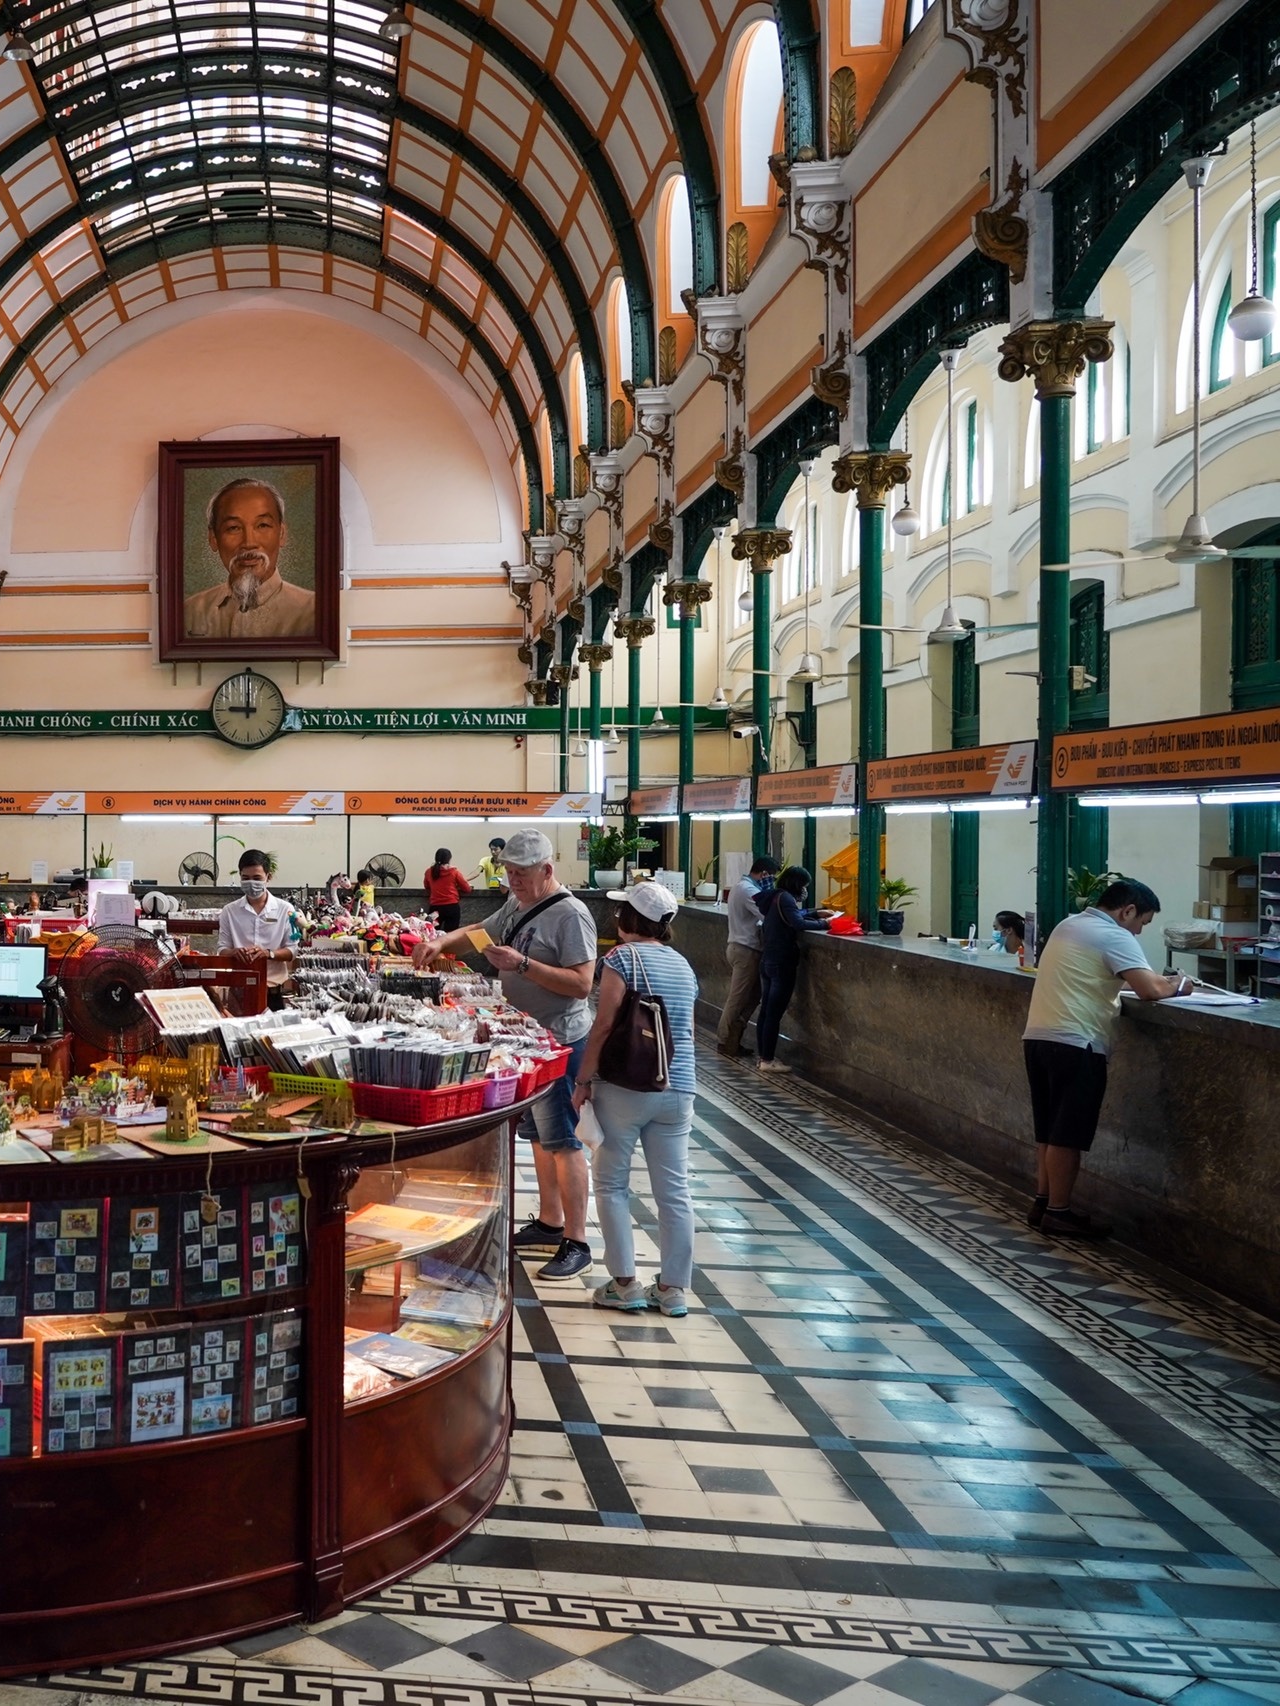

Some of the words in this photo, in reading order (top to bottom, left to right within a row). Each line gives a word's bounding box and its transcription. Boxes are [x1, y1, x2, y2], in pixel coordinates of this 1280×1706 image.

[40, 712, 92, 727] CHÓNG
[110, 712, 161, 727] CHÍNH
[167, 712, 199, 727] XÁC
[322, 710, 363, 726] TOÀN
[374, 710, 410, 728] TIỆN
[413, 712, 439, 728] LỢI
[451, 711, 482, 725] VĂN
[486, 713, 527, 725] MINH
[1057, 753, 1065, 772] 2
[105, 798, 112, 807] 8
[153, 798, 173, 807] DỊCH
[175, 799, 187, 807] VỤ
[189, 797, 212, 806] HÀNH
[214, 797, 241, 806] CHÍNH
[243, 798, 267, 806] CÔNG
[352, 799, 358, 807] 7
[395, 796, 420, 804] ĐÓNG
[422, 796, 437, 804] GÓI
[439, 796, 457, 804] BƯU
[459, 794, 484, 805] PHẨM
[486, 797, 504, 805] BƯU
[507, 797, 528, 807] KIỆN
